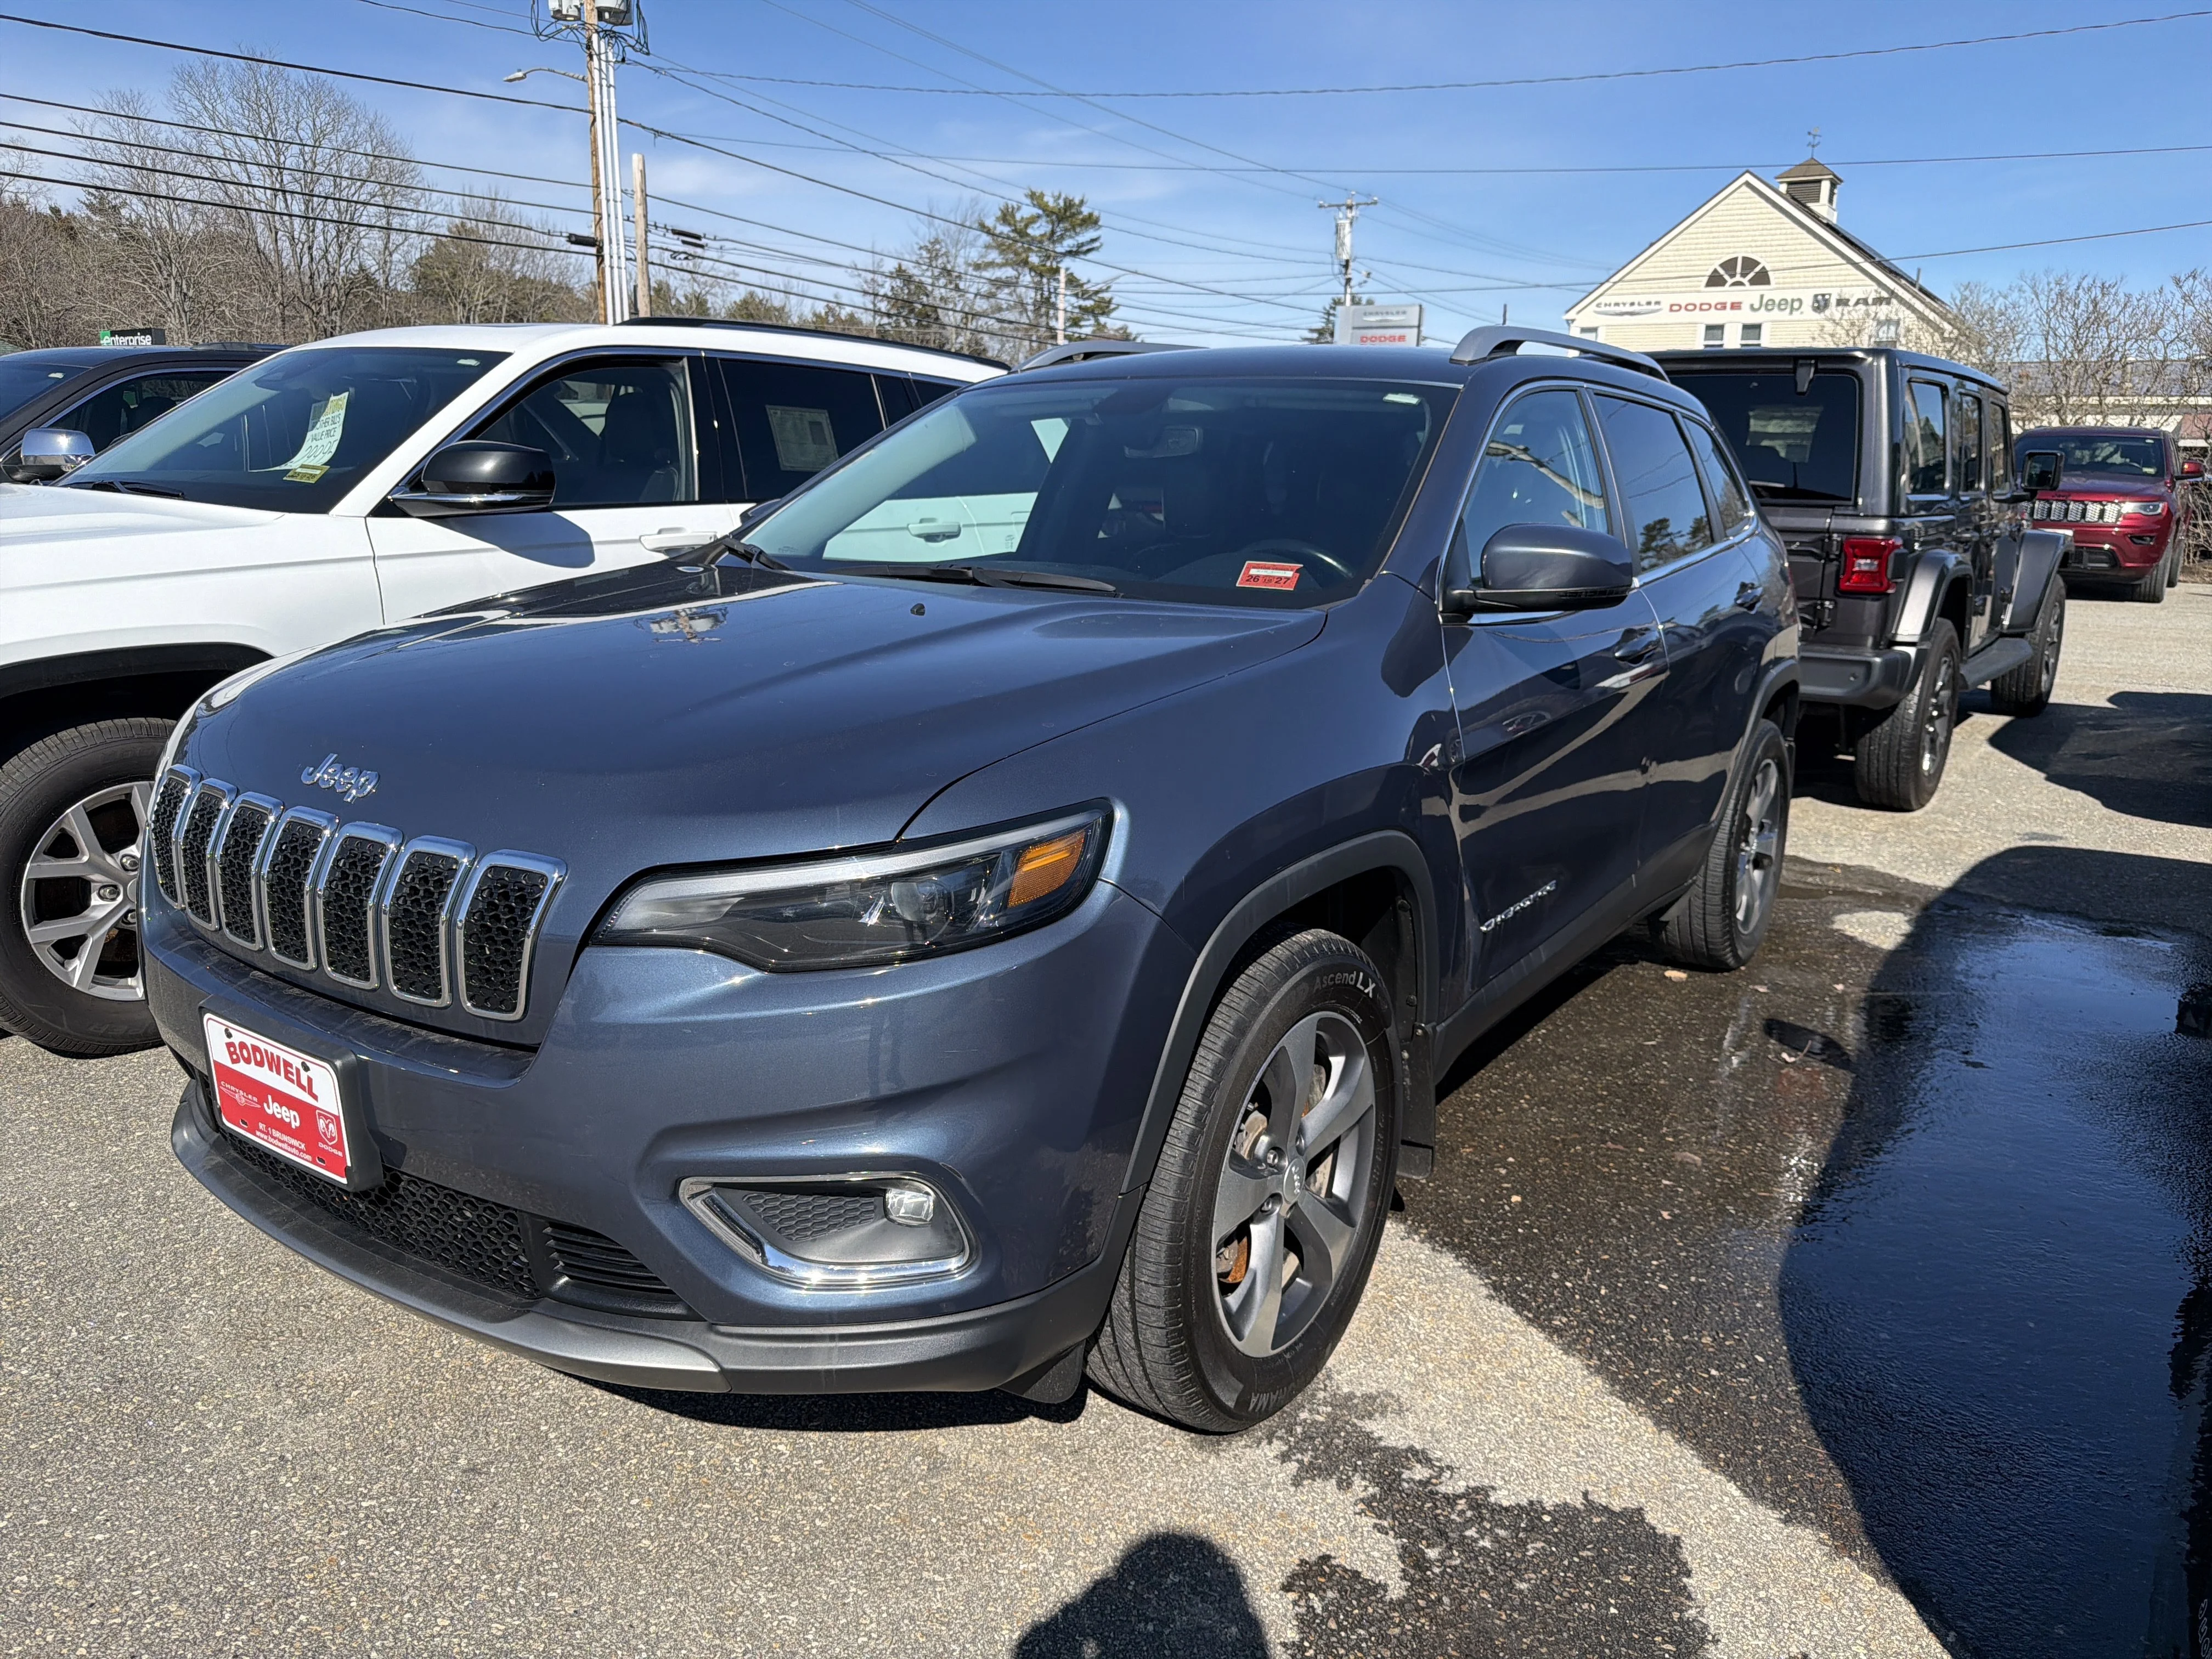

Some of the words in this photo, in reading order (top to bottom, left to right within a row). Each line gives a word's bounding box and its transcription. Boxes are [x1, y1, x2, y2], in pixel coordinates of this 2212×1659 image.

[1595, 300, 1662, 309] CHRYSLER
[1668, 301, 1744, 313] DODGE
[1750, 294, 1803, 316] Jeep
[1835, 296, 1892, 307] RAM
[101, 332, 152, 346] enterprise
[1360, 335, 1407, 343] DODGE
[1274, 577, 1291, 585] 27
[301, 753, 380, 804] Jeep
[1314, 970, 1357, 990] Ascend
[1356, 972, 1376, 998] LX
[225, 1041, 319, 1103] BODWELL
[221, 1080, 258, 1103] CHRYSLER
[263, 1094, 300, 1129] Jeep
[272, 1127, 306, 1151] BRUNSWICK
[318, 1142, 343, 1158] DODGE
